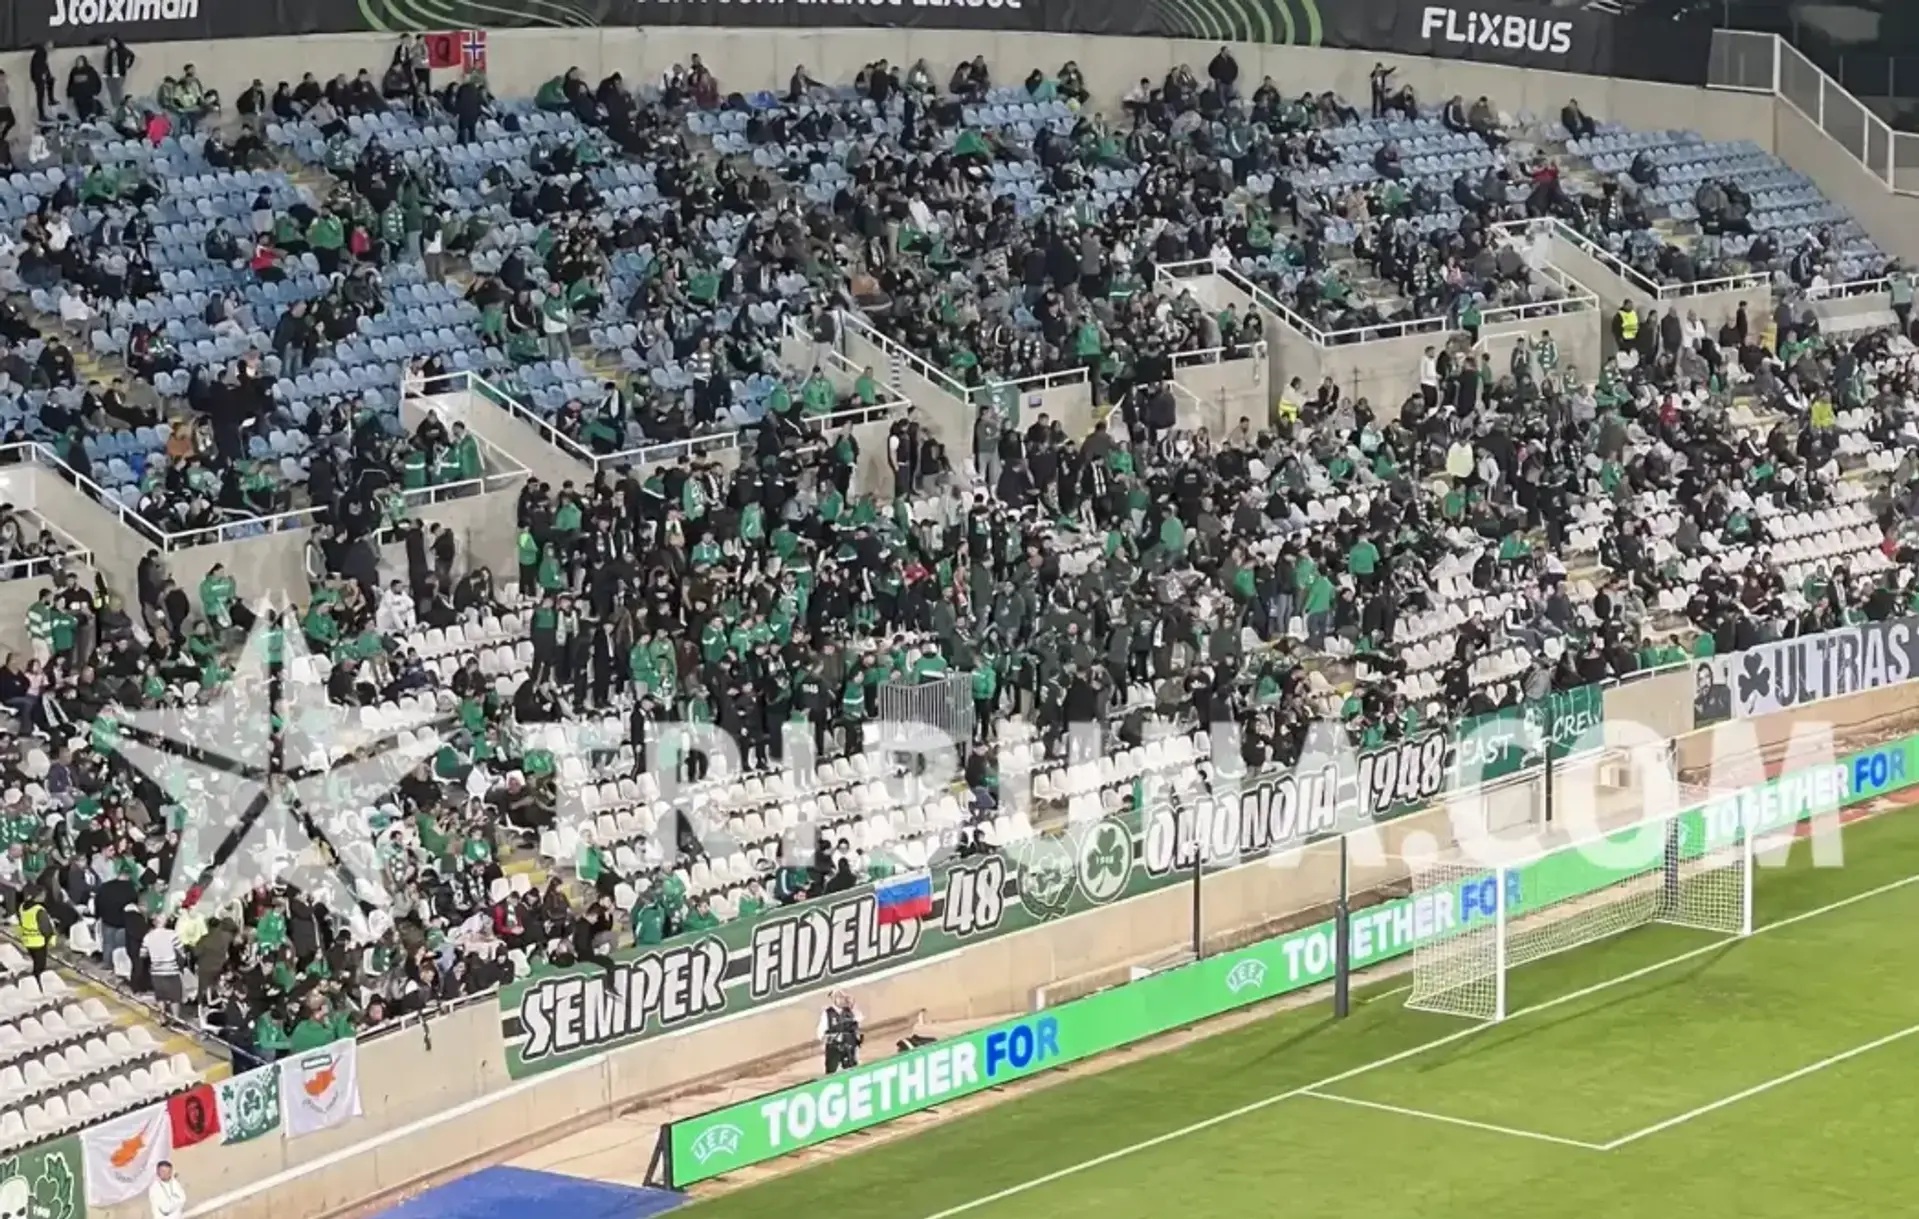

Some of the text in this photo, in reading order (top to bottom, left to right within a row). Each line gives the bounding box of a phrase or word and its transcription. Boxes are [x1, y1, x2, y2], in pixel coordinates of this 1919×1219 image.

[1774, 624, 1911, 707] ULTRAS
[1144, 732, 1446, 878] OMONOIA 1948
[1462, 733, 1515, 766] EAST
[1855, 746, 1907, 793] FOR
[519, 934, 730, 1062] SEMPER
[945, 858, 1006, 936] 48
[1227, 960, 1265, 988] UEFA
[1461, 868, 1522, 923] FOR
[693, 1016, 1060, 1160] UEFA TOGETHER FOR
